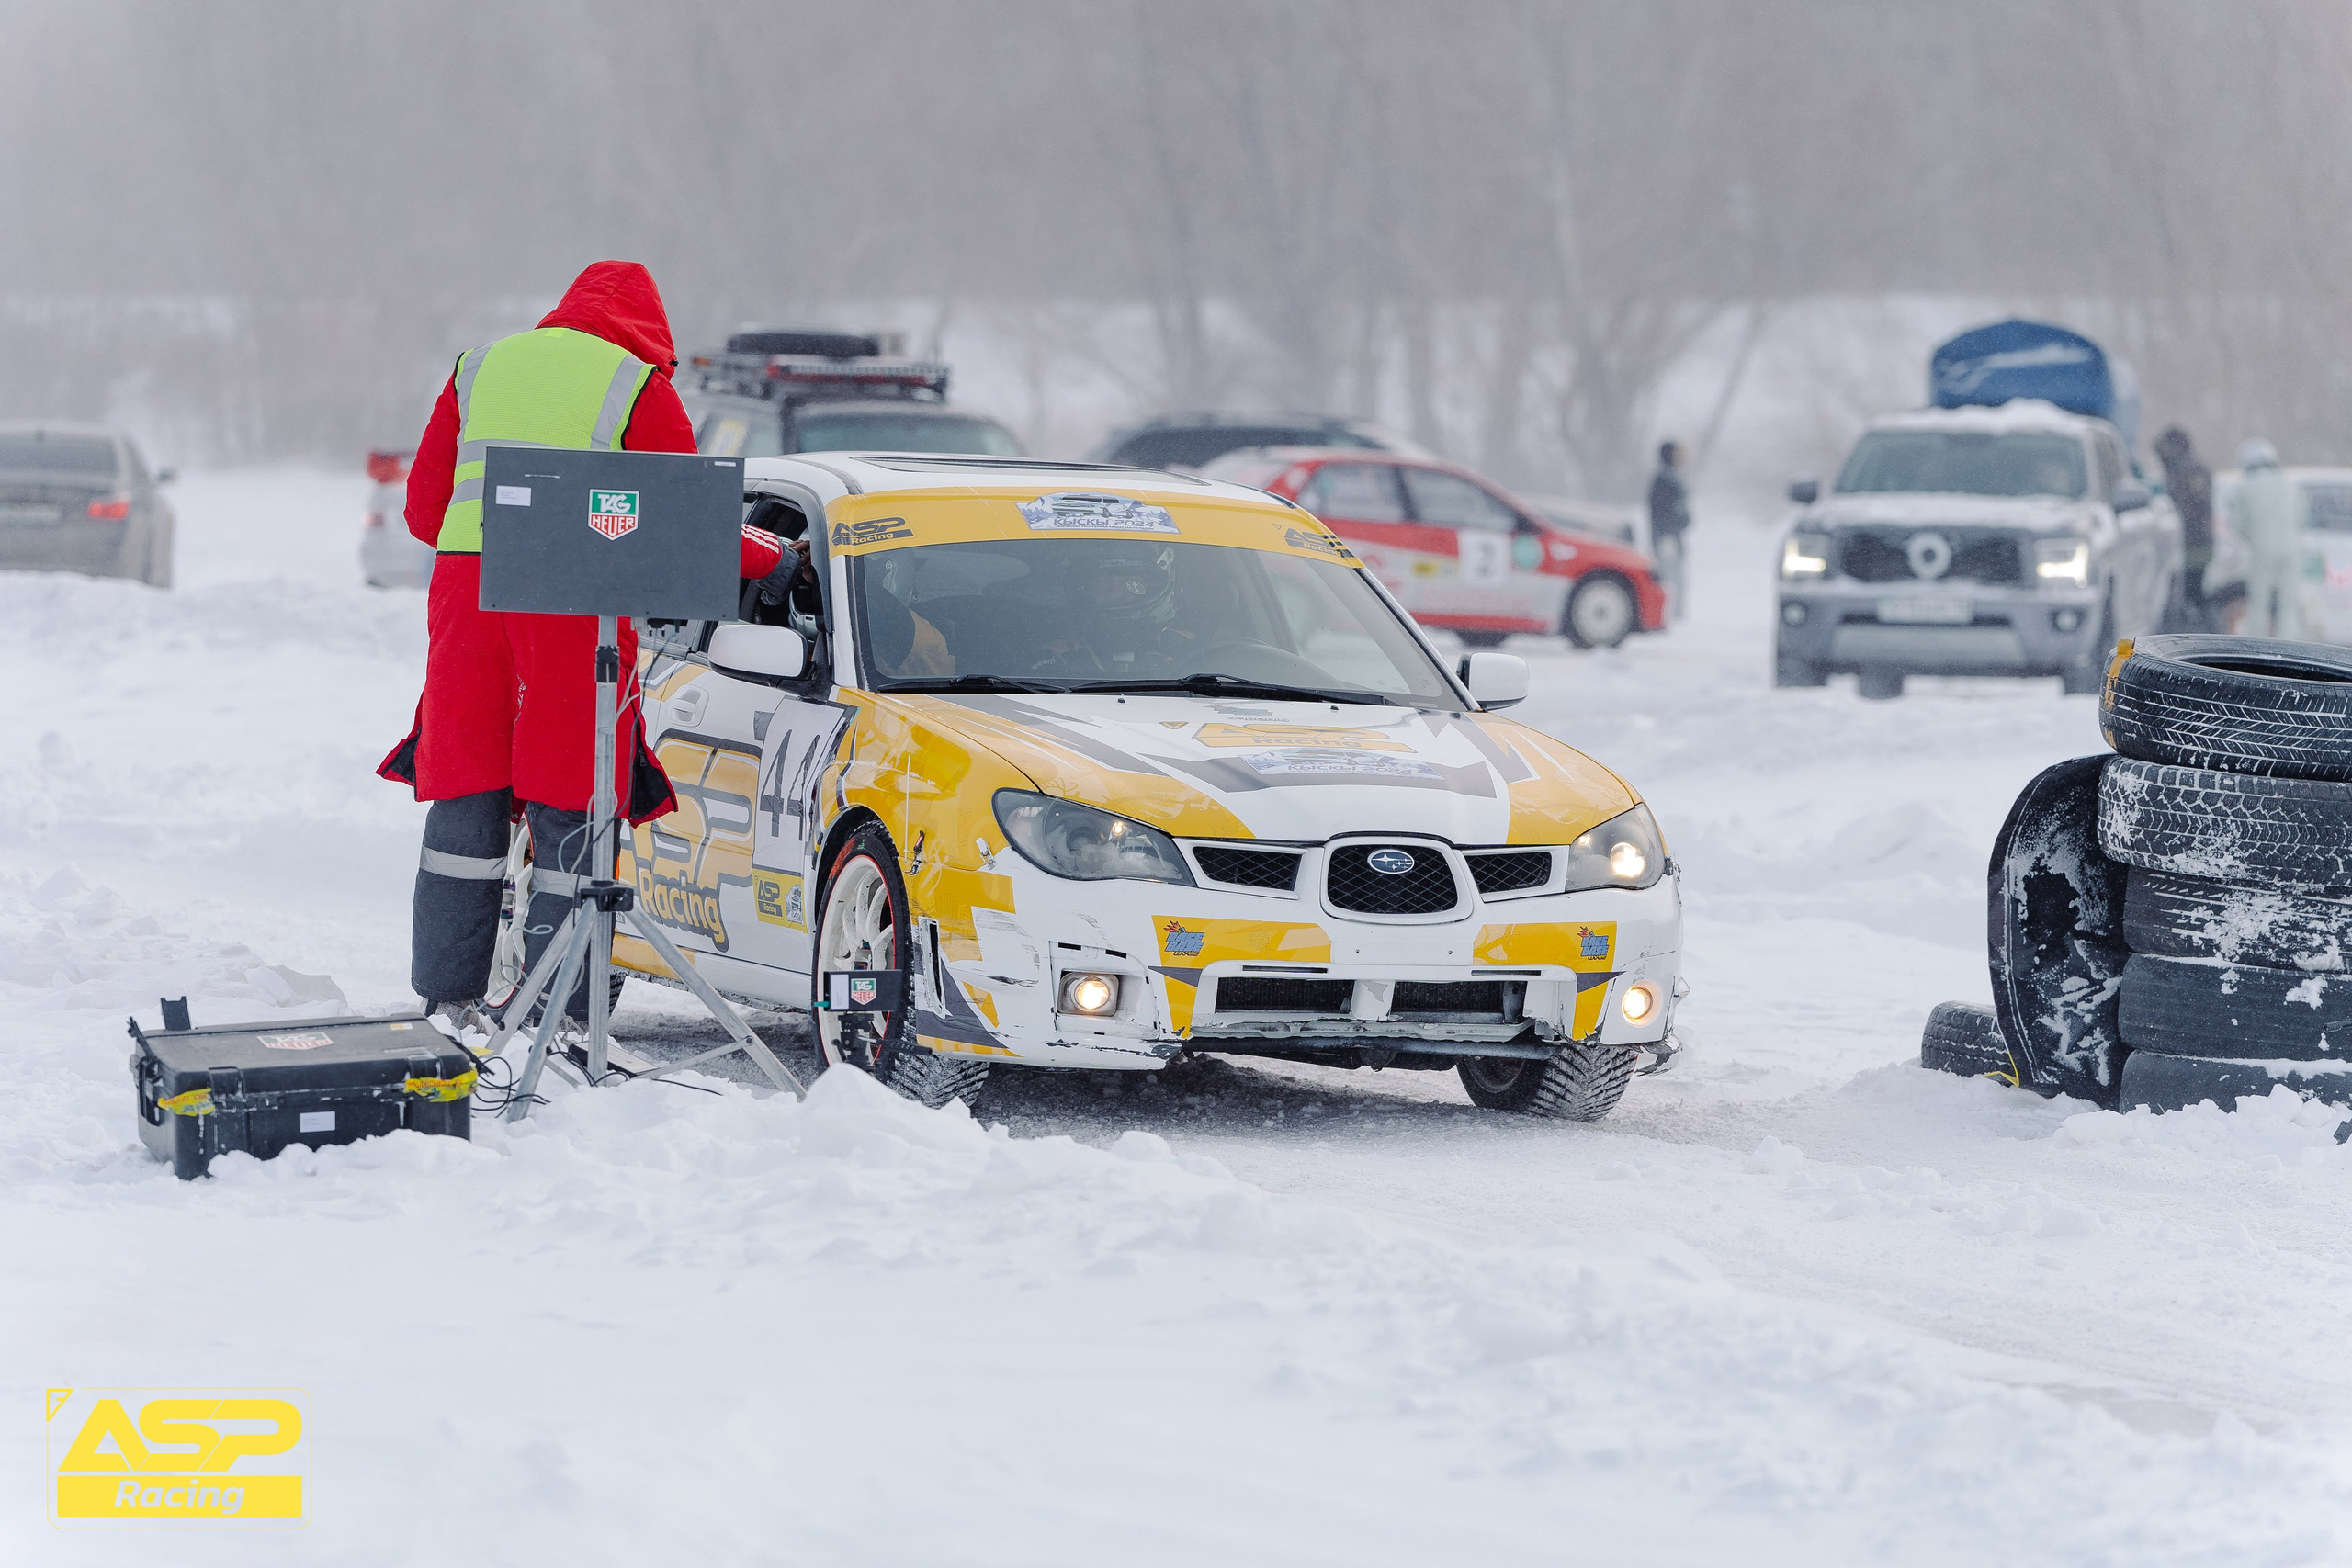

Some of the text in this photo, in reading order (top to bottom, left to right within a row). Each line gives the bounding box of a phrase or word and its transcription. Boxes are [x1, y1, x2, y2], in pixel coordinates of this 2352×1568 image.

[597, 494, 631, 513] TAG
[593, 515, 635, 536] HEUER
[831, 516, 906, 540] ASP
[852, 533, 885, 545] Racing
[1193, 722, 1390, 740] ASP
[1252, 737, 1362, 748] Racing
[760, 729, 820, 841] 44
[758, 880, 780, 903] ASP
[639, 866, 726, 944] Racing
[763, 903, 777, 915] Racing
[1166, 931, 1205, 942] RACE
[1164, 941, 1204, 953] BASE
[854, 980, 873, 991] TAG
[853, 991, 876, 1003] HEUER
